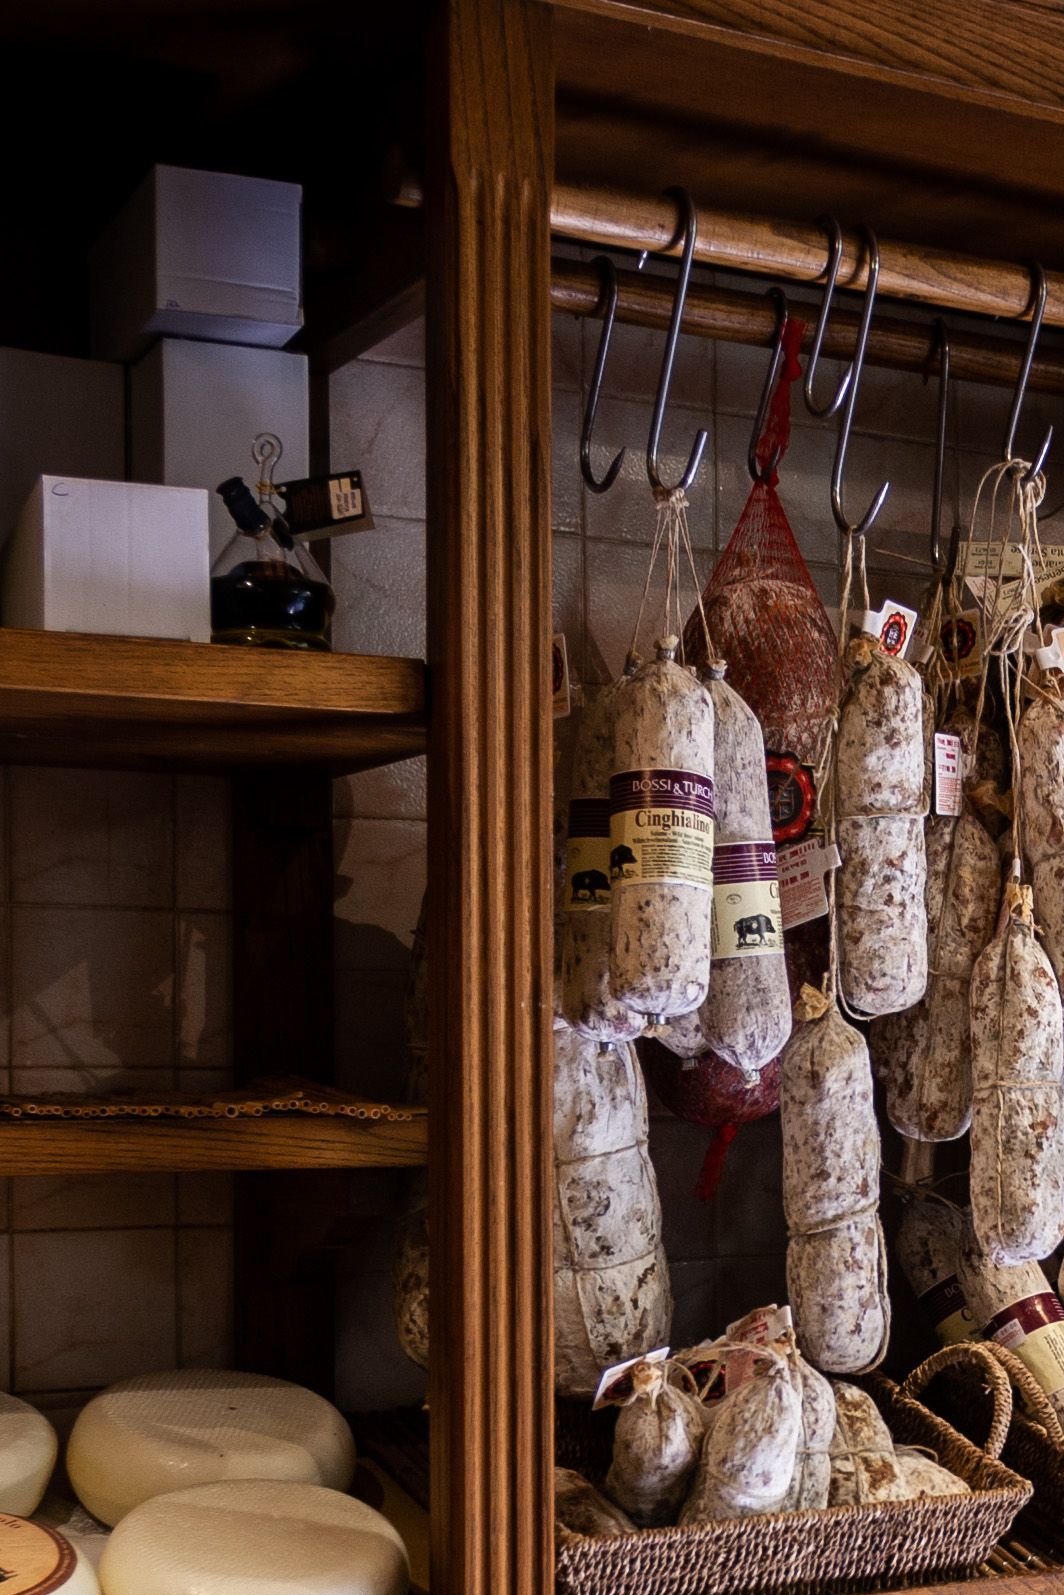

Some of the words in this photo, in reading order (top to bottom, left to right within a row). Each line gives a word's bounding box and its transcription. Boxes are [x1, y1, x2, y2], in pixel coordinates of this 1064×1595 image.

[632, 779, 671, 792] BOSSI
[672, 781, 684, 796] &
[635, 810, 710, 835] Cinghialino
